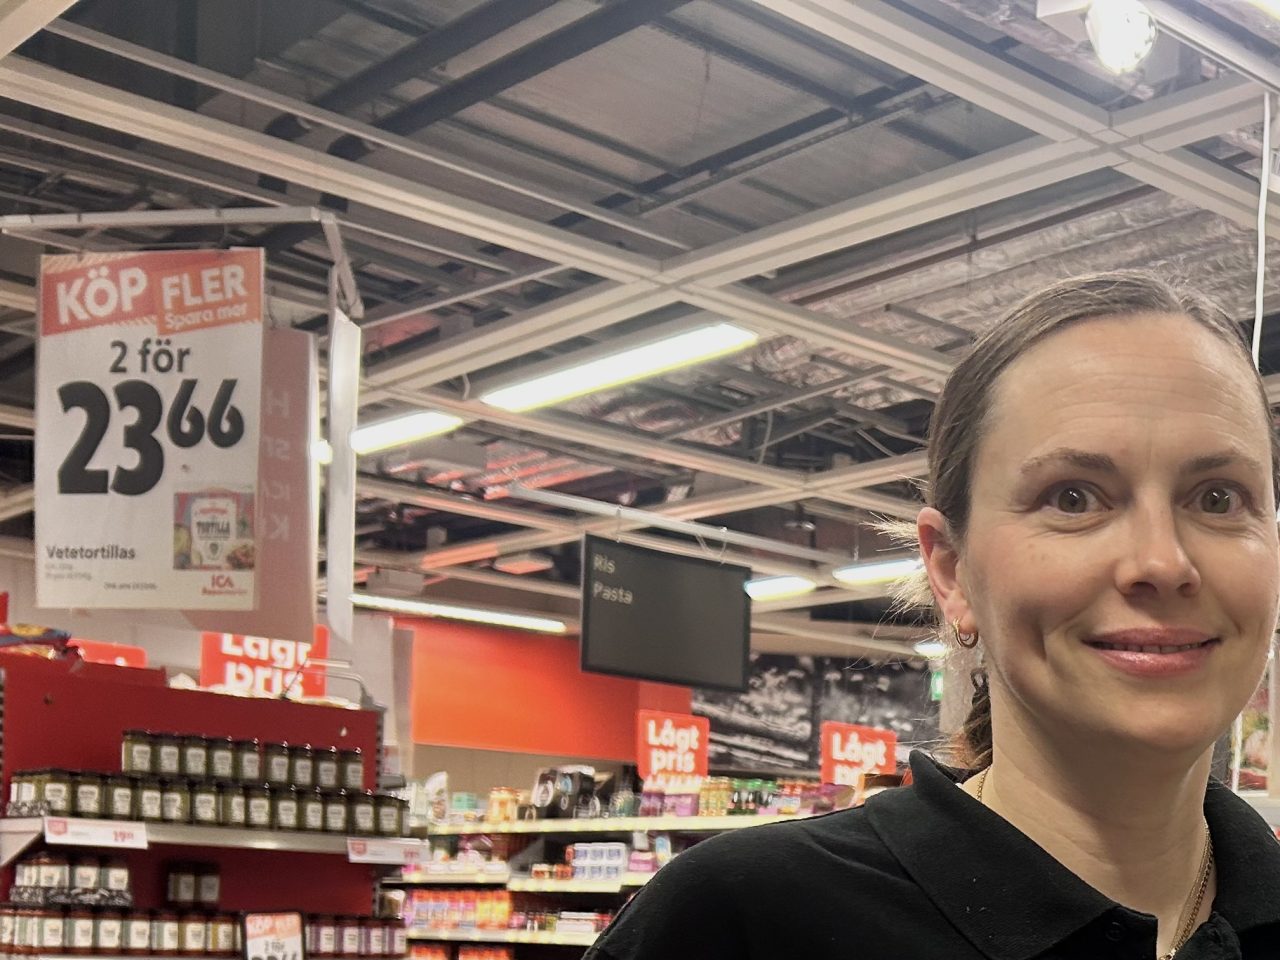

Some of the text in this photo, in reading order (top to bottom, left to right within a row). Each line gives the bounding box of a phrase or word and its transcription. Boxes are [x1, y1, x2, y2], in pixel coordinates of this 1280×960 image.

[57, 264, 247, 325] KÖP FLER
[164, 303, 248, 331] Spara mer
[110, 339, 190, 373] 2 för
[57, 378, 245, 496] 2366
[46, 544, 136, 561] Vetetortillas
[594, 554, 616, 574] Ris
[211, 574, 234, 588] ICA
[593, 582, 633, 604] Pasta
[648, 719, 699, 750] Lågt
[651, 749, 696, 776] pris
[832, 731, 887, 767] Lågt
